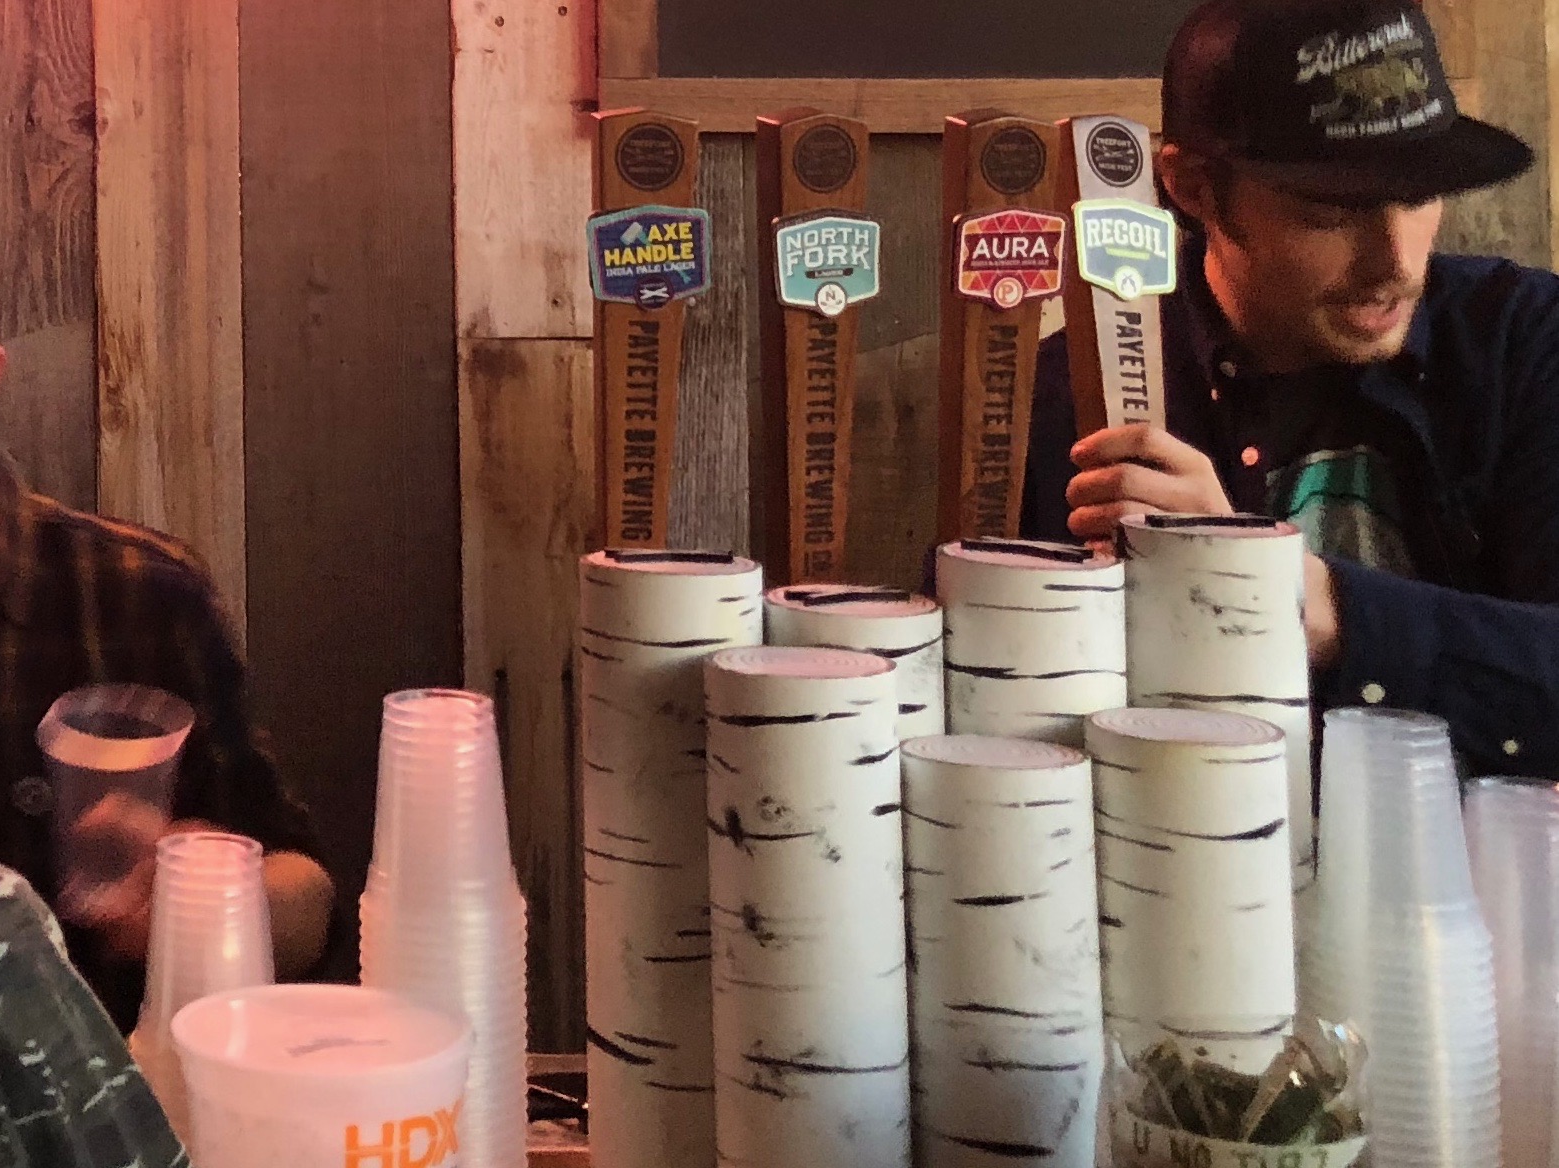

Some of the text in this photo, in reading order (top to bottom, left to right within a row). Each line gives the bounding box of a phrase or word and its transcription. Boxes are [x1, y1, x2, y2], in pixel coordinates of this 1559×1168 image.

[604, 242, 695, 267] HANDLE
[648, 222, 693, 243] AXE
[786, 228, 870, 253] NORTH
[786, 244, 871, 277] FORK
[972, 236, 1050, 260] AURA
[1085, 218, 1168, 258] RECOIL
[606, 267, 634, 278] INDIA
[624, 320, 660, 421] PAYETTE
[806, 319, 839, 426] PAYETTE
[982, 324, 1020, 427] PAYETTE
[1115, 310, 1149, 412] PAYETTE
[621, 429, 657, 541] BREWING
[804, 431, 837, 545] BREWING
[345, 1094, 465, 1168] HDX
